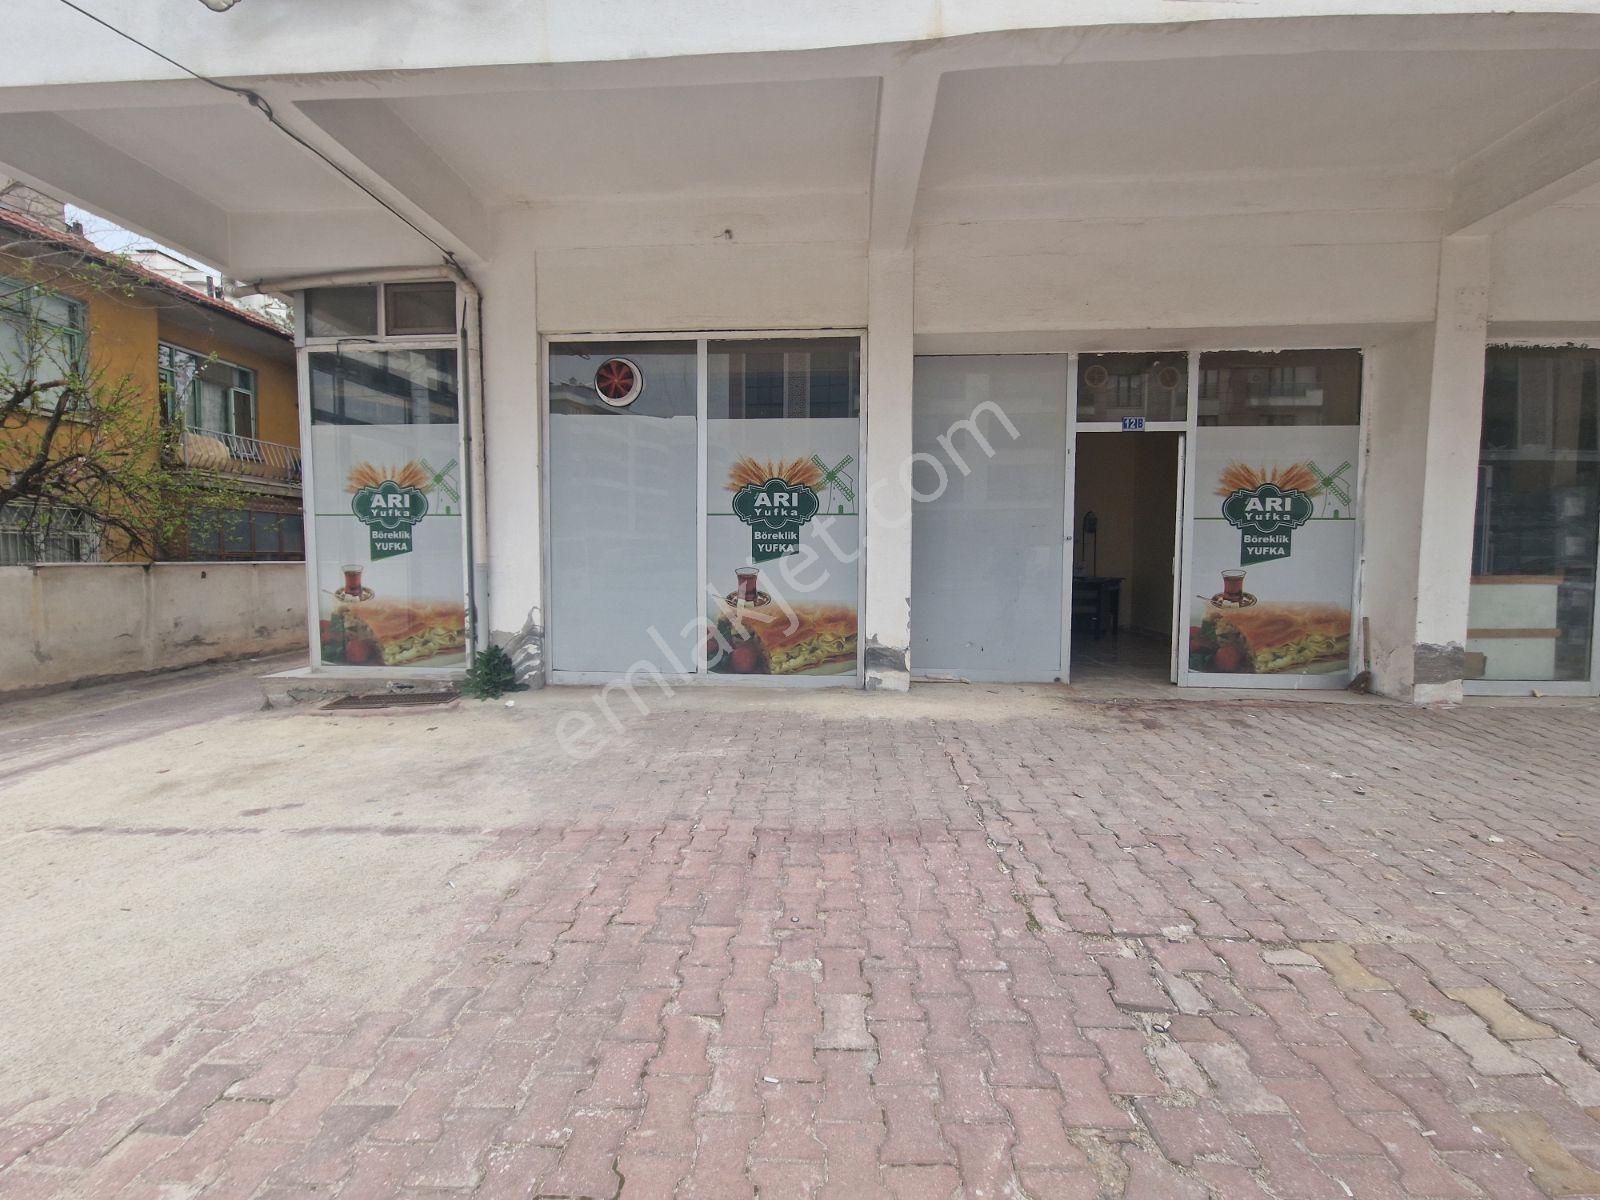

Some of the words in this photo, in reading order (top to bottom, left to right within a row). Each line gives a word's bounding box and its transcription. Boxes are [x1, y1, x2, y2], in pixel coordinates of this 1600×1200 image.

[370, 493, 410, 508] ARI
[754, 492, 798, 507] ARI
[1245, 498, 1292, 512] ARI
[371, 508, 410, 517] Yufka
[754, 508, 798, 516] Yufka
[1245, 512, 1291, 521] Yufka
[372, 530, 410, 539] Böreklik
[754, 531, 797, 540] Böreklik
[1243, 535, 1289, 543] Böreklik
[375, 542, 408, 551] YUFKA
[758, 543, 794, 552] YUFKA
[1247, 547, 1285, 555] YUFKA
